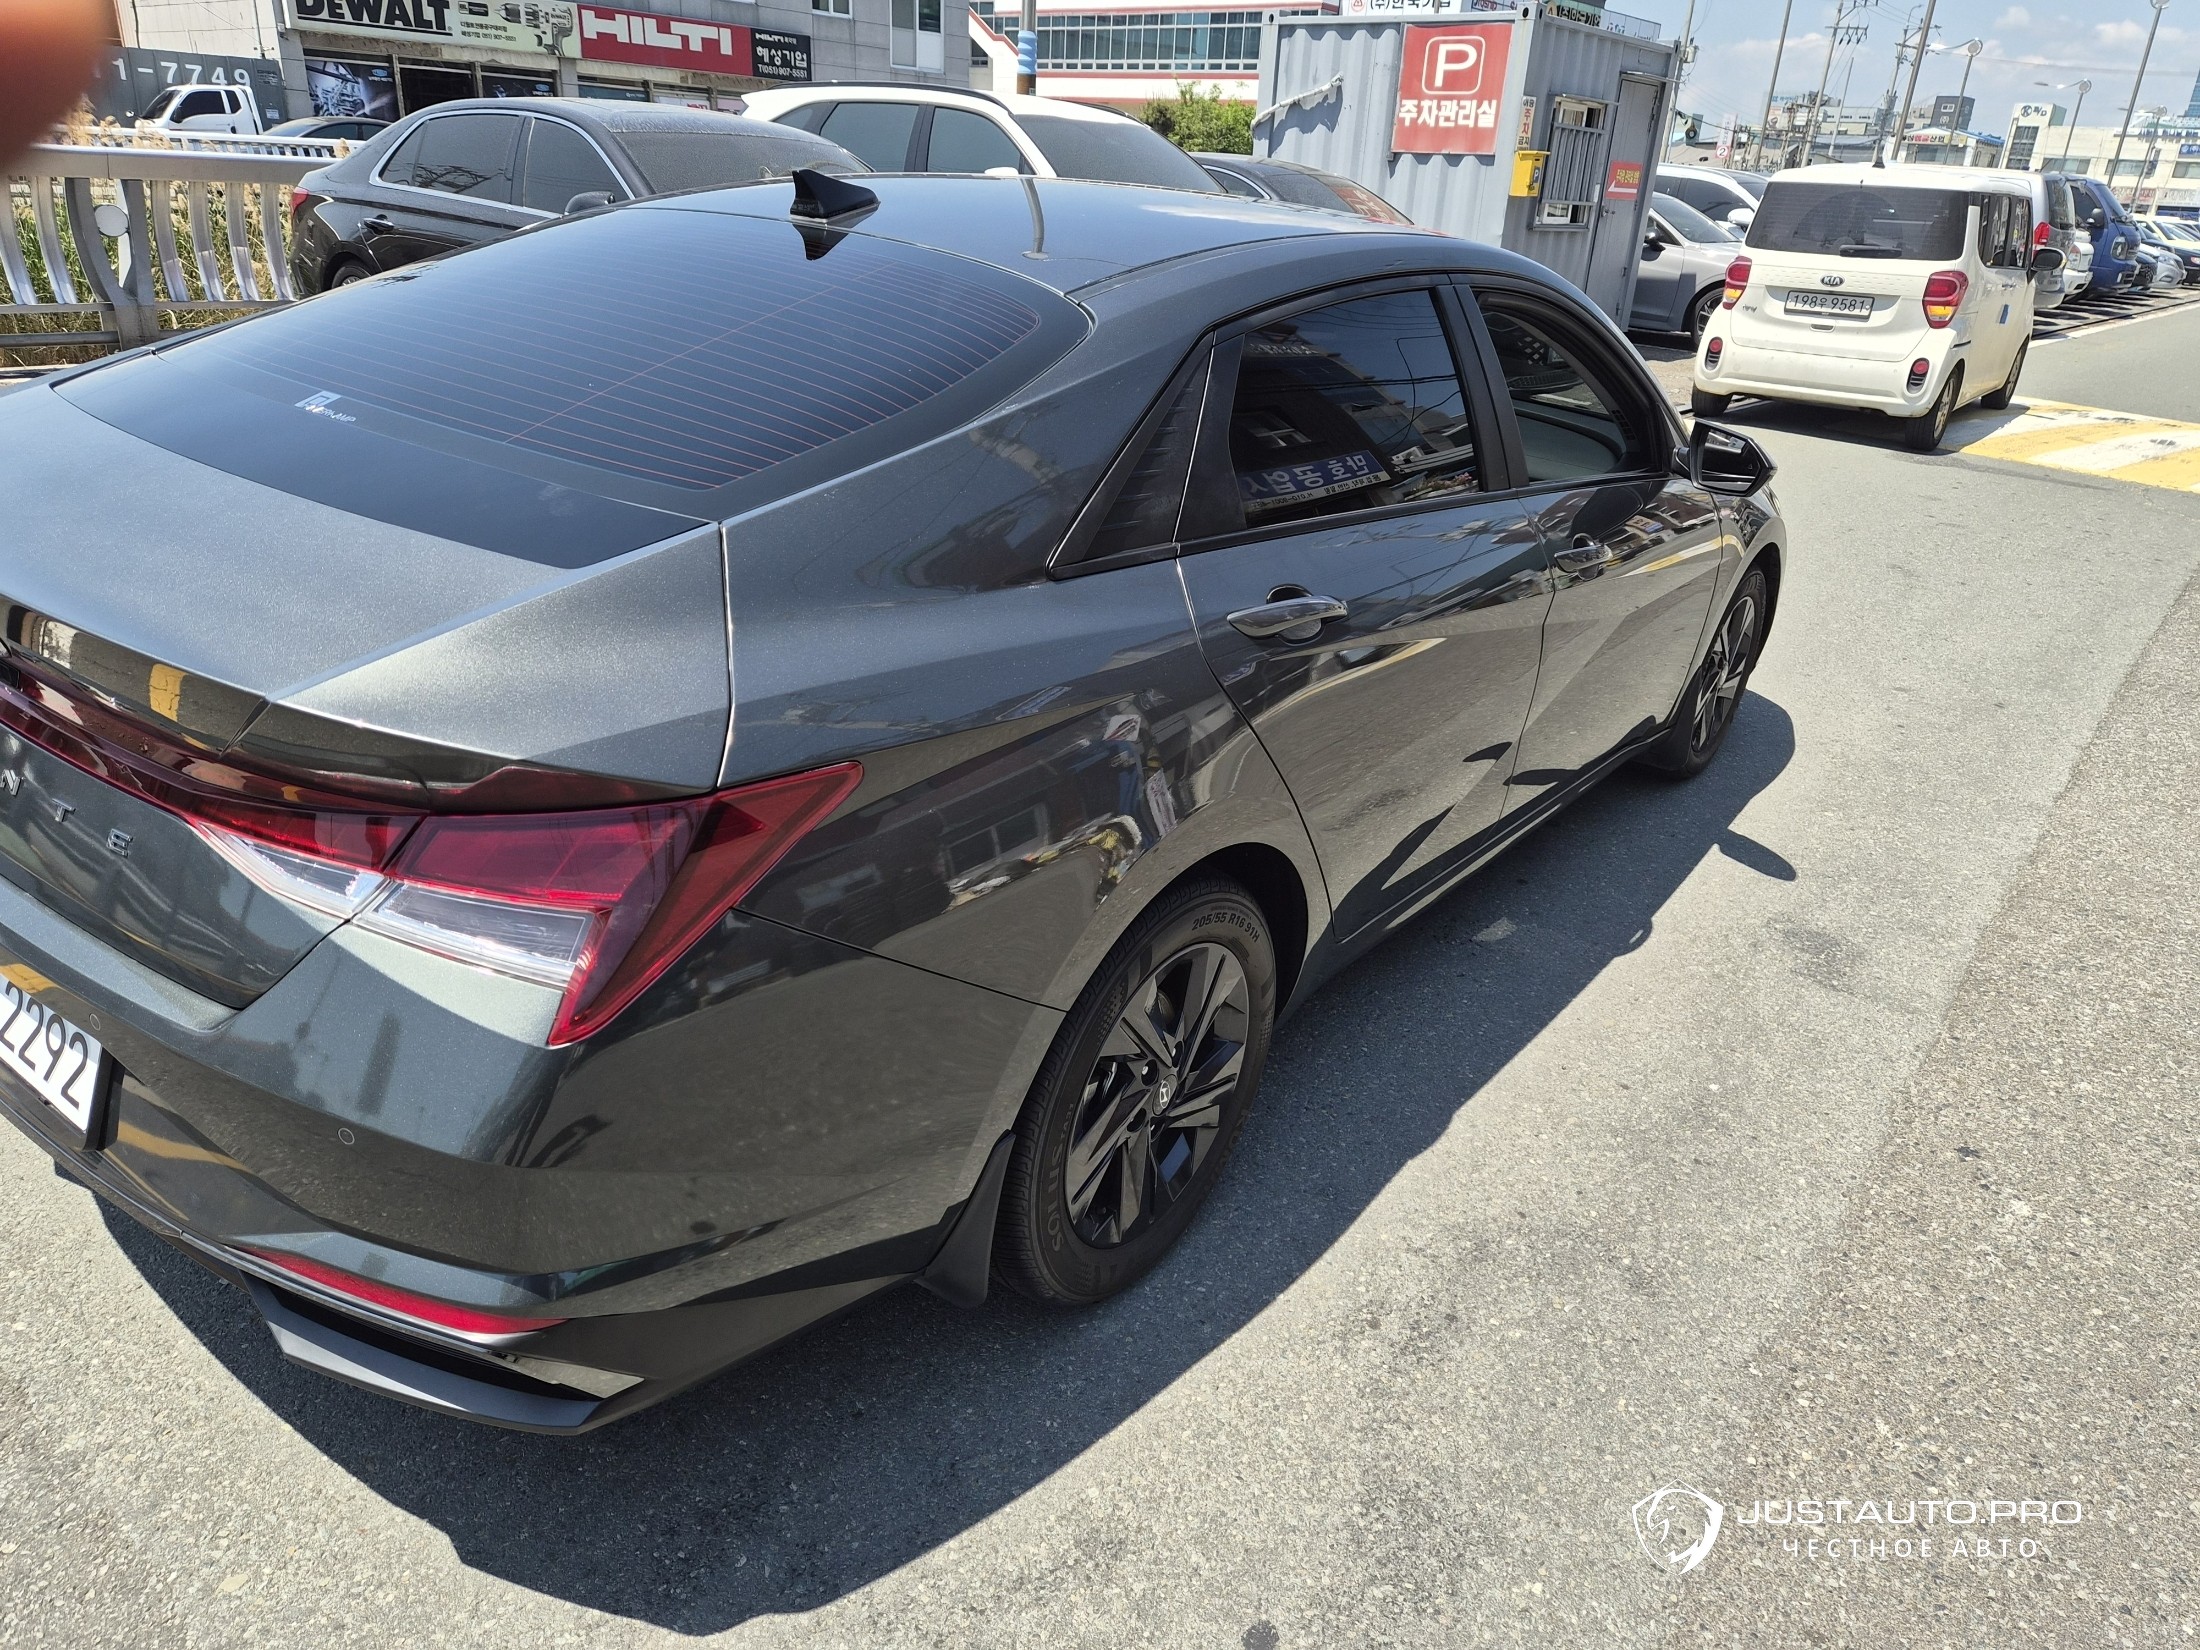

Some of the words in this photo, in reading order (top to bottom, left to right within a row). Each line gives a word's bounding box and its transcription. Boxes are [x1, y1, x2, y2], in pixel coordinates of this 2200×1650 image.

[296, 0, 450, 31] DEWALT
[580, 8, 733, 56] HILTI
[755, 32, 784, 43] HILTI
[94, 57, 251, 86] 1-7749
[1434, 43, 1478, 87] P
[1398, 99, 1498, 128] 주차관리실
[1823, 275, 1842, 285] KIA
[1793, 294, 1827, 309] 198우
[1831, 297, 1867, 313] 9581
[0, 769, 133, 858] NTE
[1192, 912, 1228, 931] 205/55
[1227, 912, 1246, 928] R16
[1244, 922, 1260, 943] 91H
[0, 980, 88, 1111] 2292
